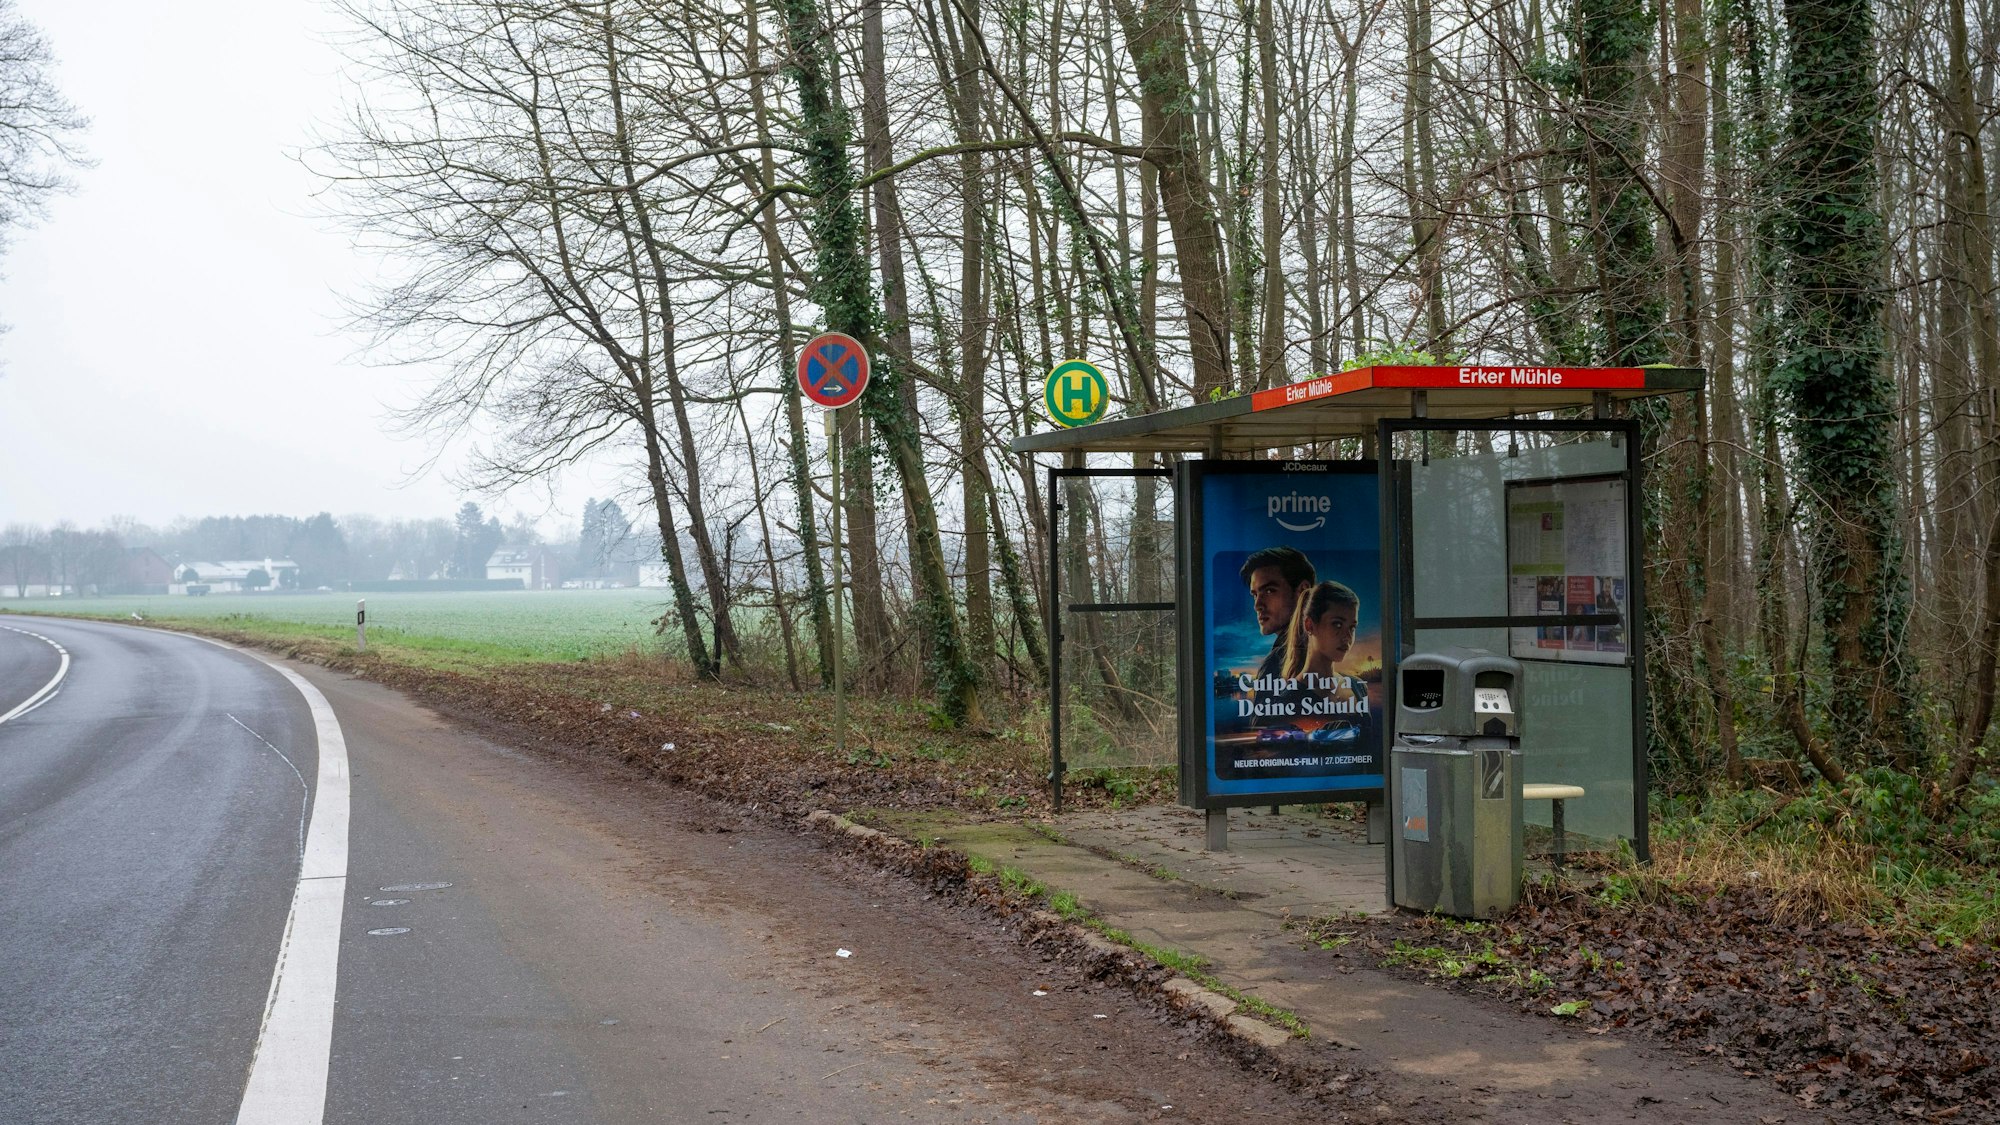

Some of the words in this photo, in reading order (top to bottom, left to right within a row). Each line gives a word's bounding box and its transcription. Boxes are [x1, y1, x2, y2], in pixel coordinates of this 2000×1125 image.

[1459, 368, 1505, 385] Erker
[1510, 367, 1562, 385] Mühle
[1062, 376, 1091, 412] H
[1286, 385, 1307, 402] Erker
[1308, 381, 1332, 398] Mühle
[1282, 462, 1328, 472] JCDecaux
[1268, 490, 1331, 517] prime
[1238, 672, 1298, 697] Culpa
[1303, 672, 1351, 694] Tuya
[1238, 698, 1296, 717] Deine
[1301, 696, 1369, 716] Schuld
[1234, 759, 1258, 768] NEUER
[1259, 757, 1318, 767] ORIGINALS-FILM
[1335, 755, 1372, 764] DEZEMBER
